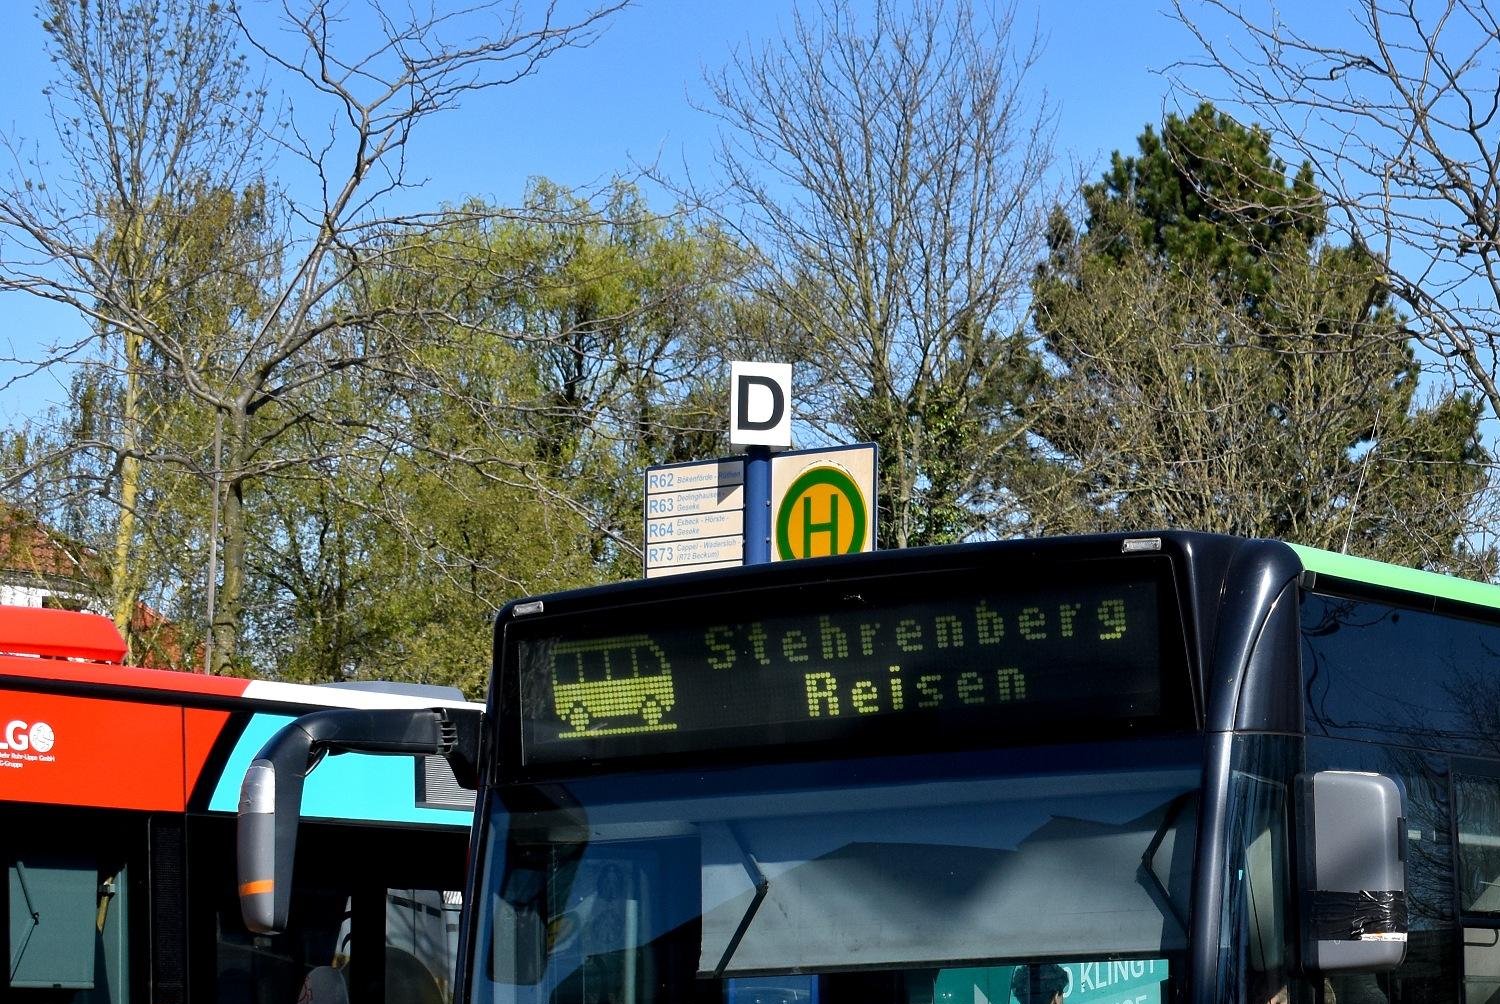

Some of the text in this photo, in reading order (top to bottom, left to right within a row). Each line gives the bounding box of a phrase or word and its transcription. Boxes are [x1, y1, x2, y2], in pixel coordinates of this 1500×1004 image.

[738, 375, 785, 431] D
[649, 473, 674, 489] R62
[649, 498, 674, 514] R63
[649, 522, 673, 538] R64
[803, 493, 839, 560] H
[649, 547, 673, 562] R73
[705, 600, 1126, 669] Stehrenberg
[805, 666, 1026, 716] Reisen
